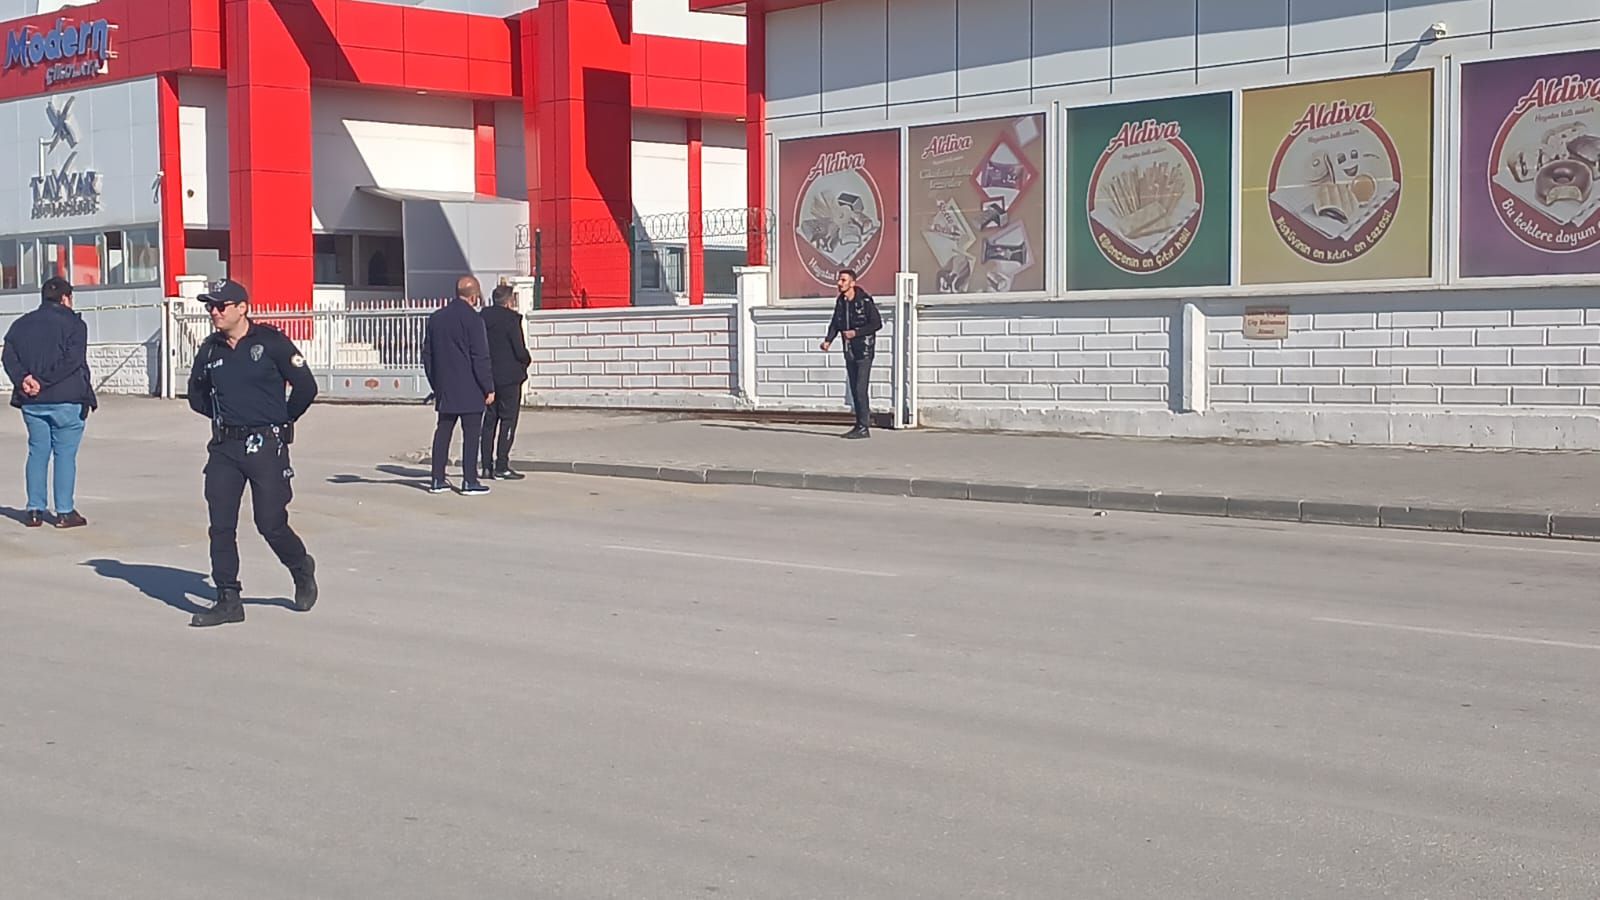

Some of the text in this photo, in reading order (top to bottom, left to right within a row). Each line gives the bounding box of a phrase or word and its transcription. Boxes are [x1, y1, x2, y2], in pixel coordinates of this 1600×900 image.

[5, 18, 109, 69] Modern
[1290, 98, 1374, 135] Aldiva
[921, 133, 973, 159] Aldiva
[1105, 118, 1181, 153] Aldiva
[808, 150, 865, 181] Aldiva
[1501, 198, 1597, 246] Bu keklere doyum
[1142, 258, 1154, 267] en
[1313, 249, 1324, 259] en
[1354, 241, 1367, 253] en
